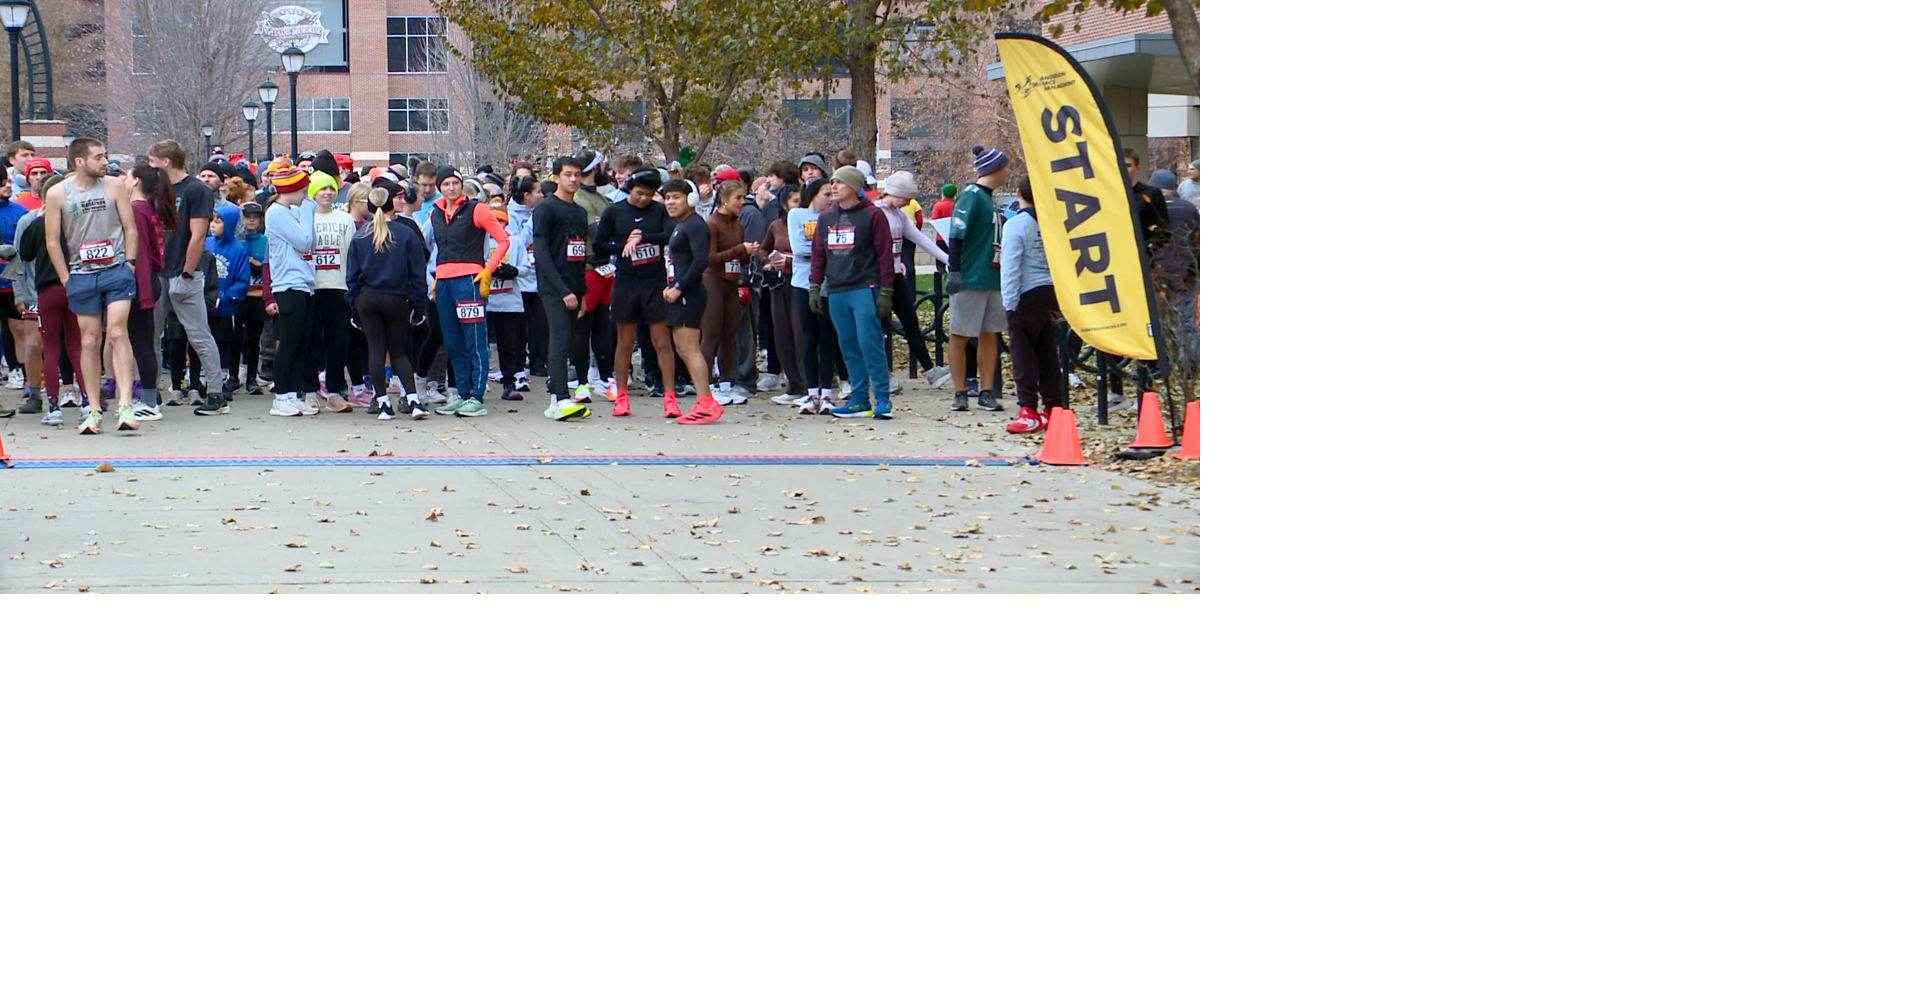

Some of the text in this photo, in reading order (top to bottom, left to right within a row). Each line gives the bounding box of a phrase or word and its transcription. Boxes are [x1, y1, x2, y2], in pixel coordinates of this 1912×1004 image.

[1041, 105, 1121, 314] START
[836, 234, 847, 244] 75
[86, 247, 109, 260] 822
[635, 247, 656, 259] 610
[316, 255, 335, 265] 612
[460, 307, 479, 318] 879
